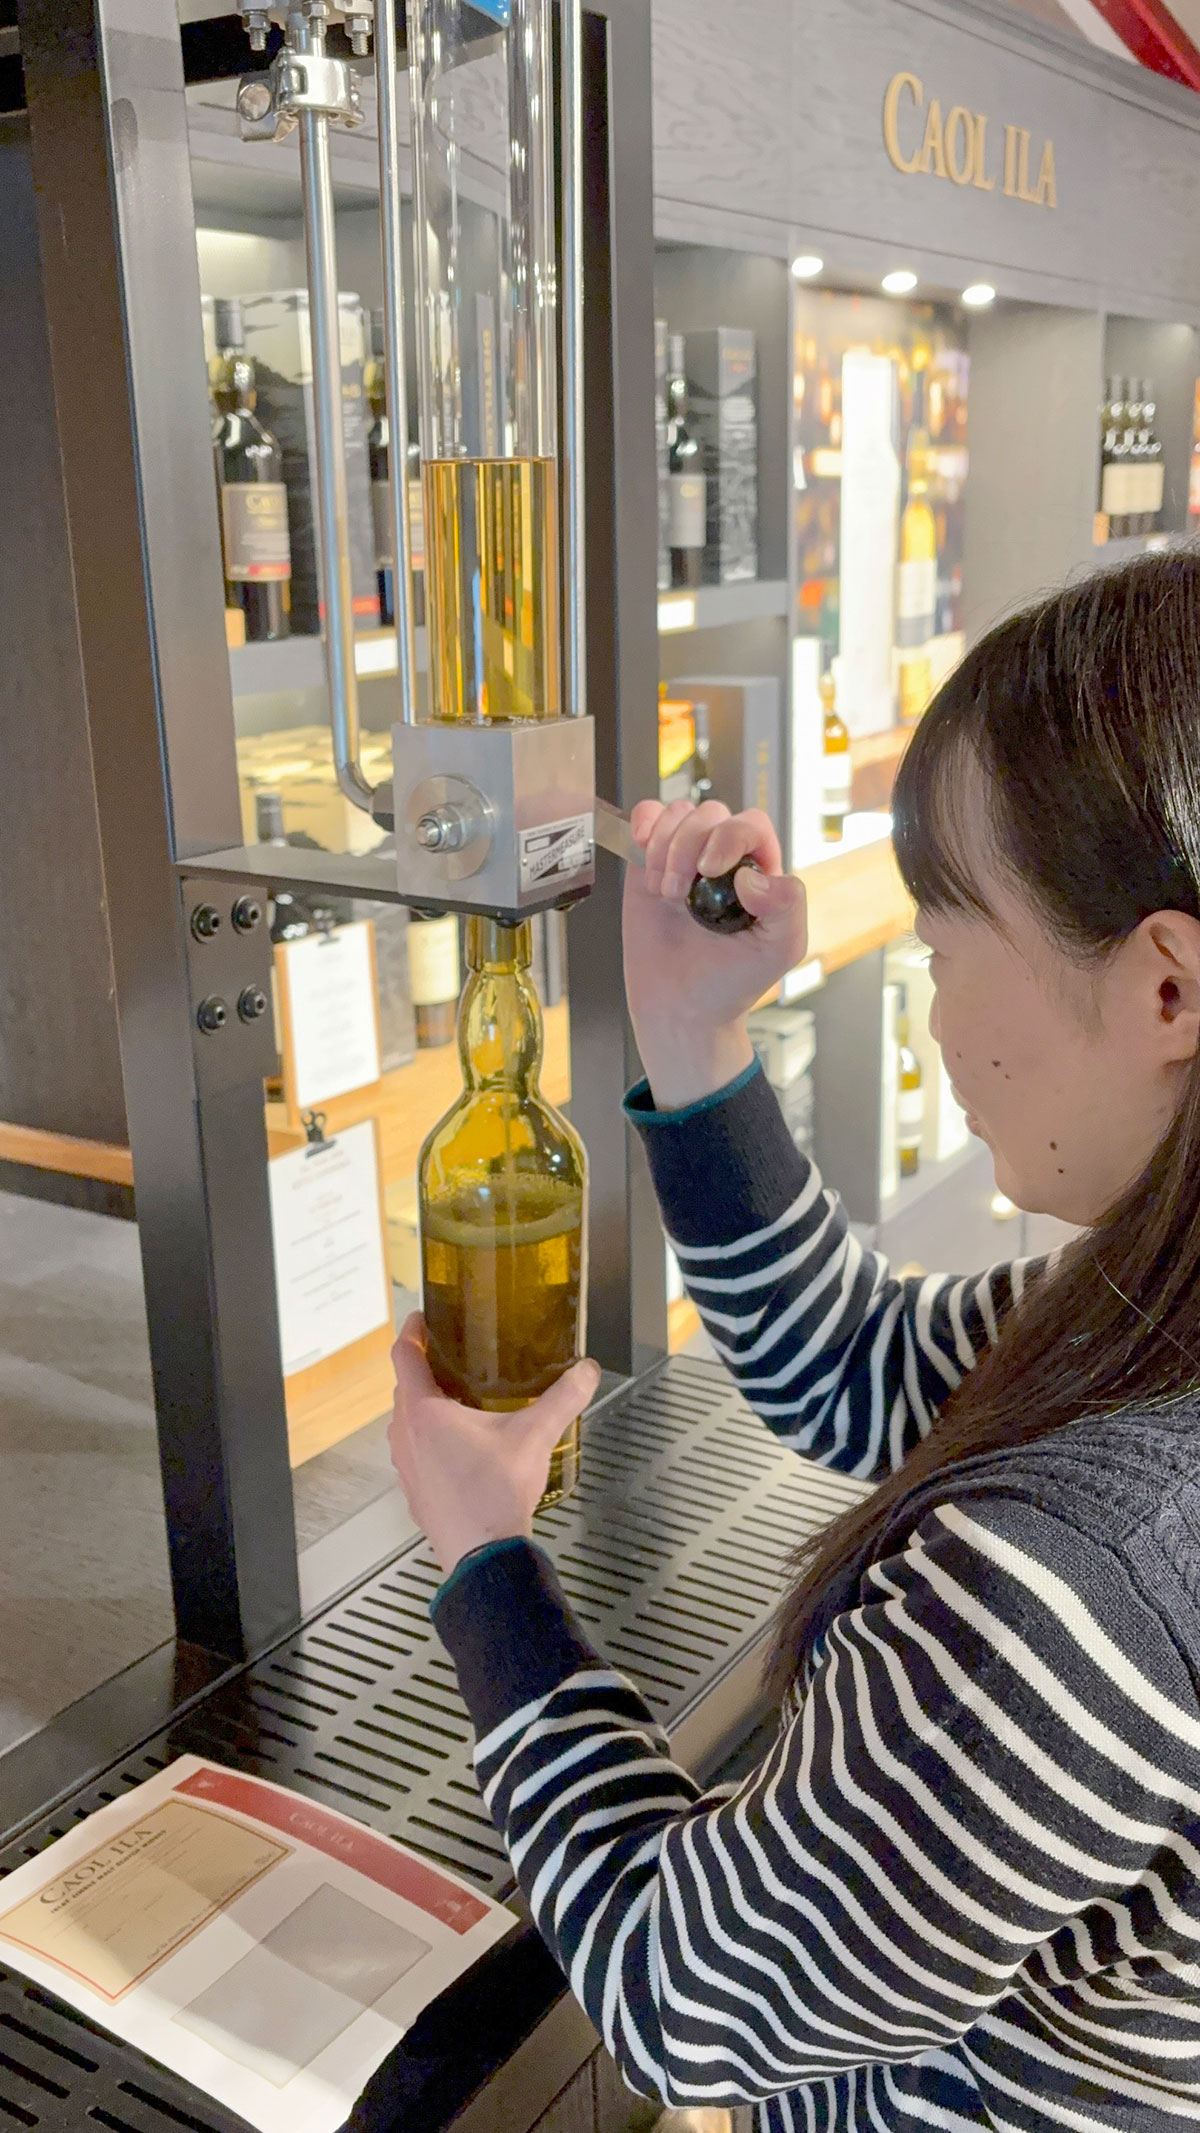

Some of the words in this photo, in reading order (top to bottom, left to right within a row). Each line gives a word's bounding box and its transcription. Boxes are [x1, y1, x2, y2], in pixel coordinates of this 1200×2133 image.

[883, 72, 995, 191] CAOL
[1003, 124, 1058, 208] ILA
[40, 1858, 113, 1905] CAOL
[110, 1829, 152, 1855] ILA
